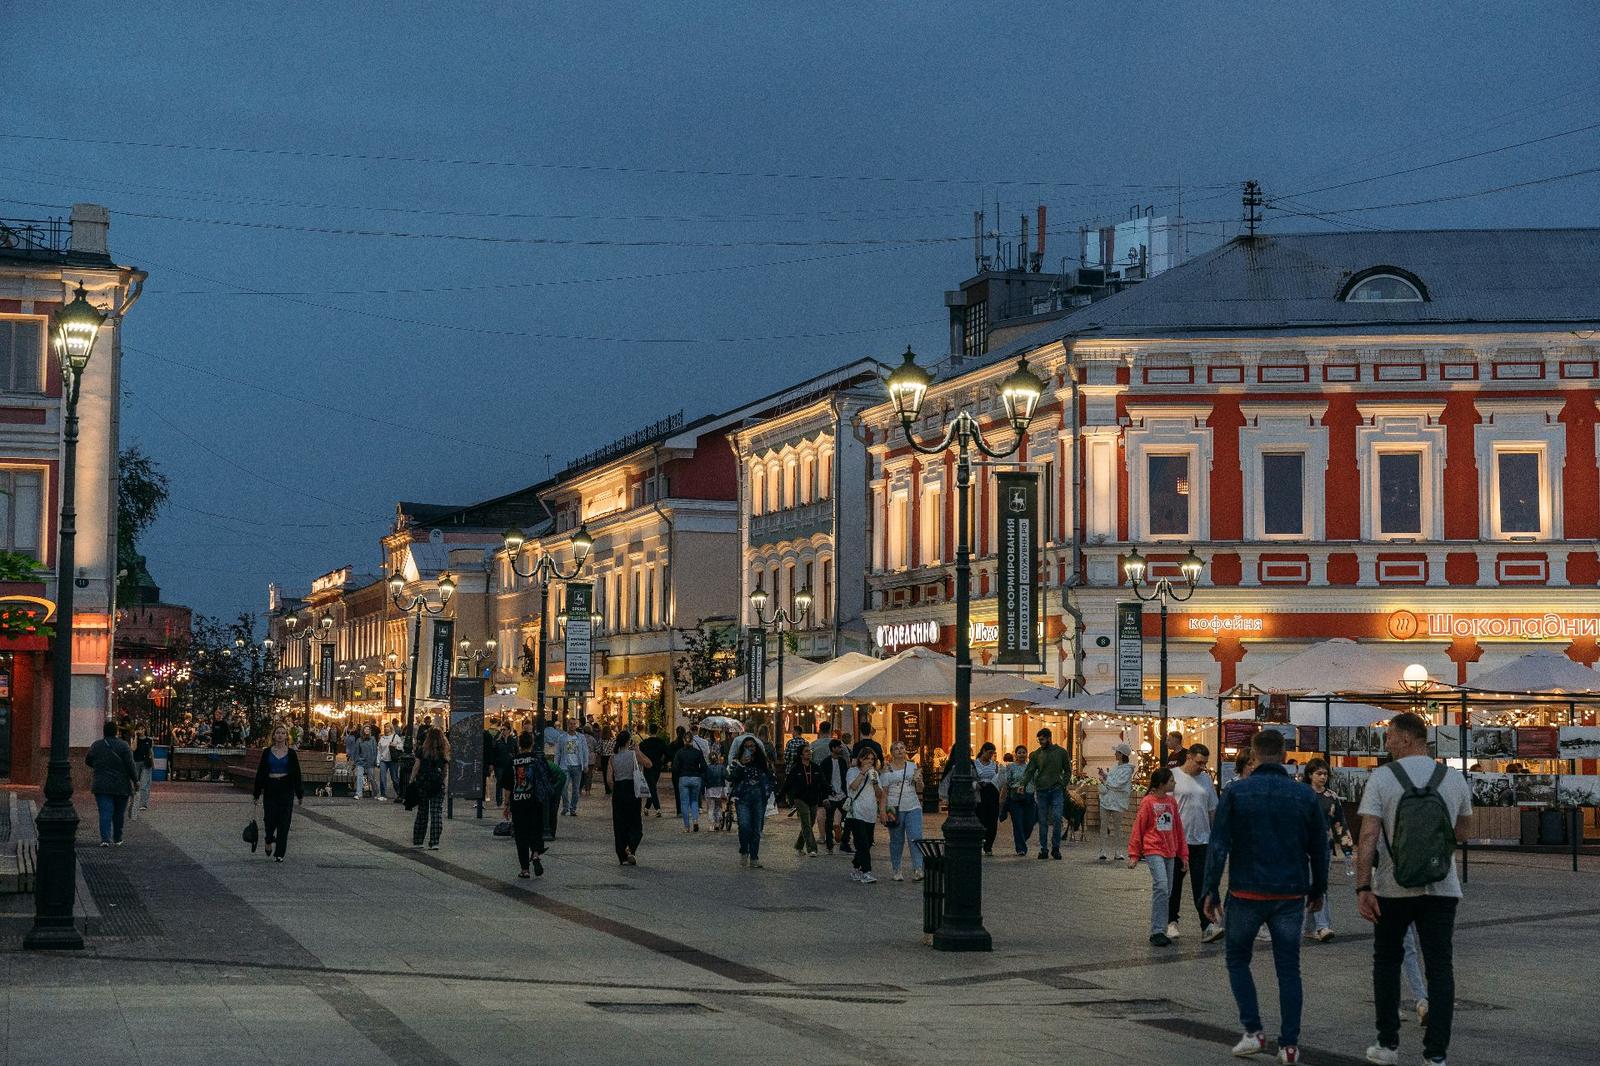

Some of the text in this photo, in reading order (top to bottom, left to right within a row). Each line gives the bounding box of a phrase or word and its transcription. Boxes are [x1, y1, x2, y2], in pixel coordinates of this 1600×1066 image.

[1007, 518, 1015, 650] НОВЫЕ ФОРМИРОВАНИЯ
[1021, 602, 1028, 612] 17
[1021, 613, 1028, 623] 10
[1189, 615, 1263, 633] кофейня
[1428, 613, 1600, 636] Шоколадни
